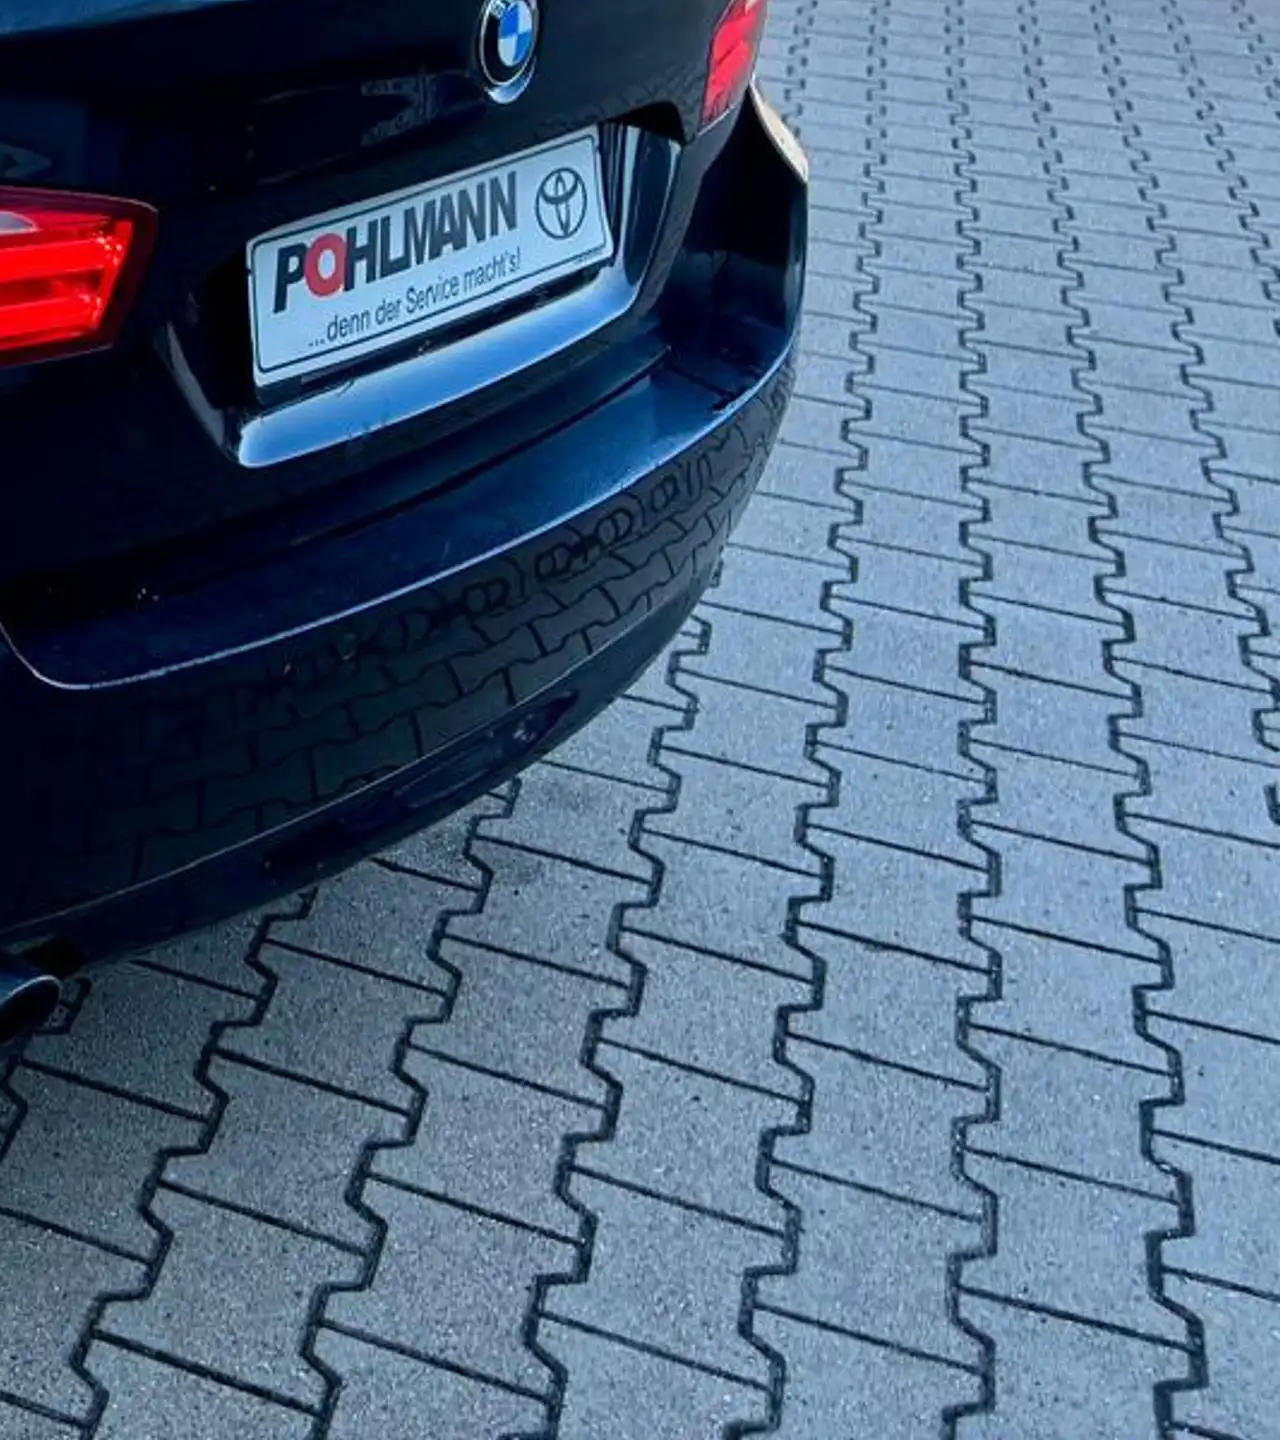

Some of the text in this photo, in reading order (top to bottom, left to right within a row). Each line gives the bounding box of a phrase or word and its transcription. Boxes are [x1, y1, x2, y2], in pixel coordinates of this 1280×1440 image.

[272, 170, 518, 314] POHLMANN
[374, 297, 402, 326] der
[405, 274, 460, 315] Service
